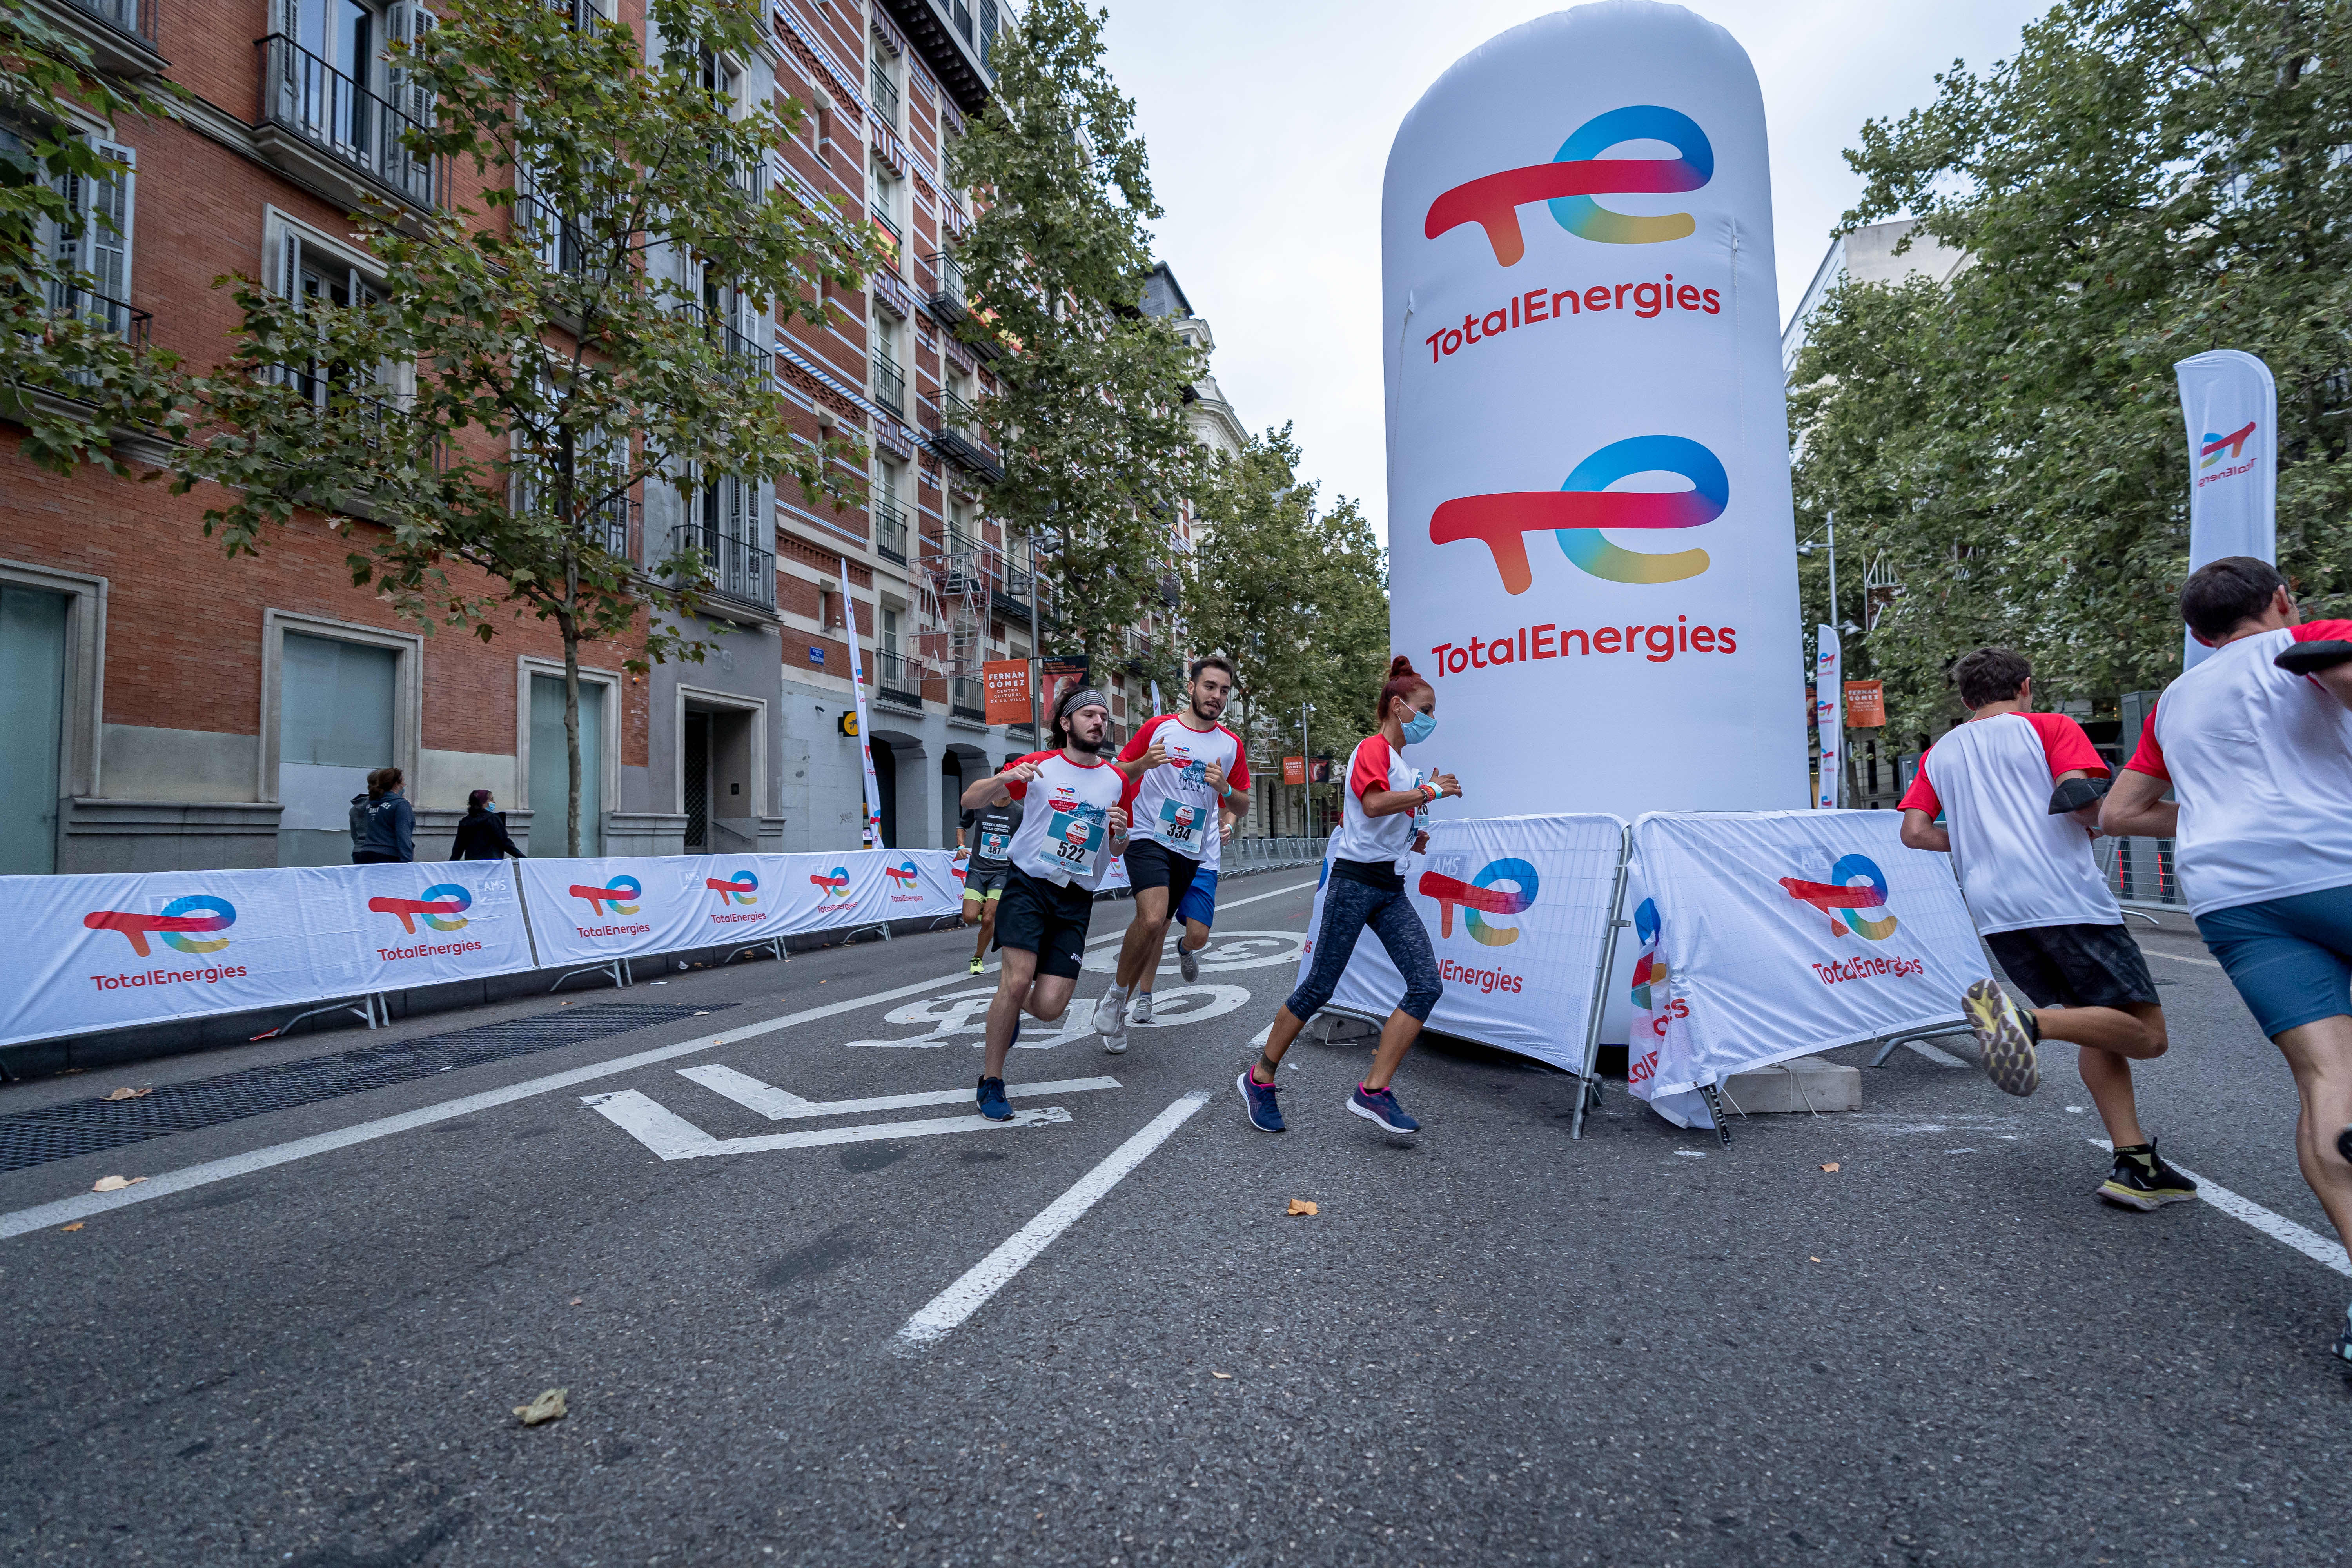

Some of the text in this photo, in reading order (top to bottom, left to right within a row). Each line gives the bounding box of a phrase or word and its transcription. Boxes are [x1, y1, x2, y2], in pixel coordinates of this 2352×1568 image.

[1426, 274, 1720, 363] TotalEnergies
[1432, 614, 1737, 677] TotalEnergies
[989, 670, 1024, 680] FERNÁN
[989, 680, 1024, 688] GÓMEZ
[1167, 823, 1192, 841] 334
[988, 846, 1001, 855] 487
[1057, 841, 1085, 863] 522
[891, 895, 923, 903] TotalEnergies
[711, 911, 766, 924] TotalEnergies
[577, 923, 650, 938] TotalEnergies
[377, 940, 481, 961] TotalEnergies
[90, 964, 247, 991] TotalEnergies
[1436, 959, 1523, 994] lEnergies
